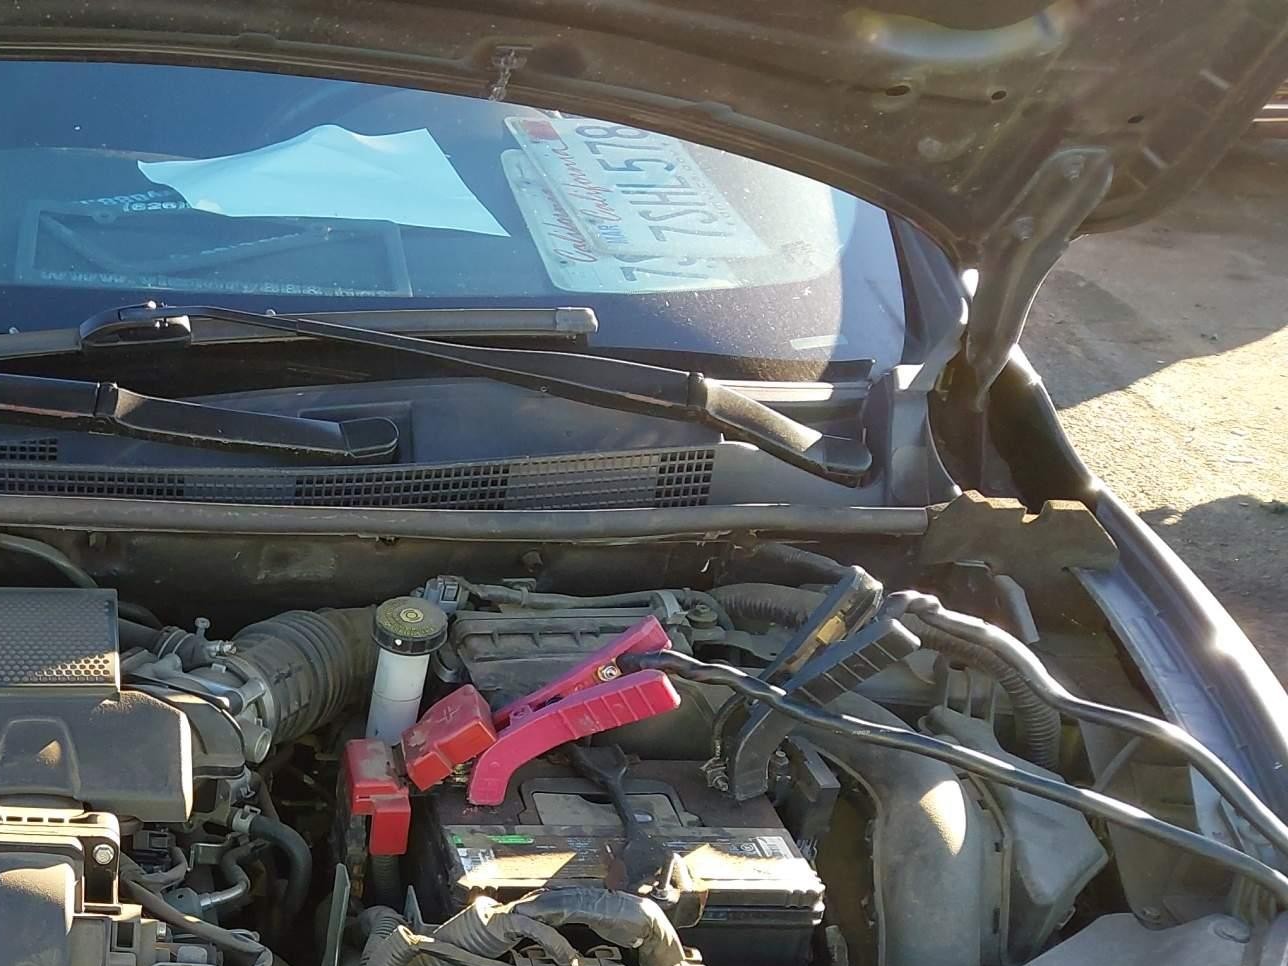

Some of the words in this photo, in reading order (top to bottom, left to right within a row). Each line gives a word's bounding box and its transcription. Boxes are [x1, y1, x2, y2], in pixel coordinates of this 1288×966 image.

[550, 139, 622, 222] California
[575, 125, 734, 242] 7SHL578
[597, 224, 629, 245] MAR
